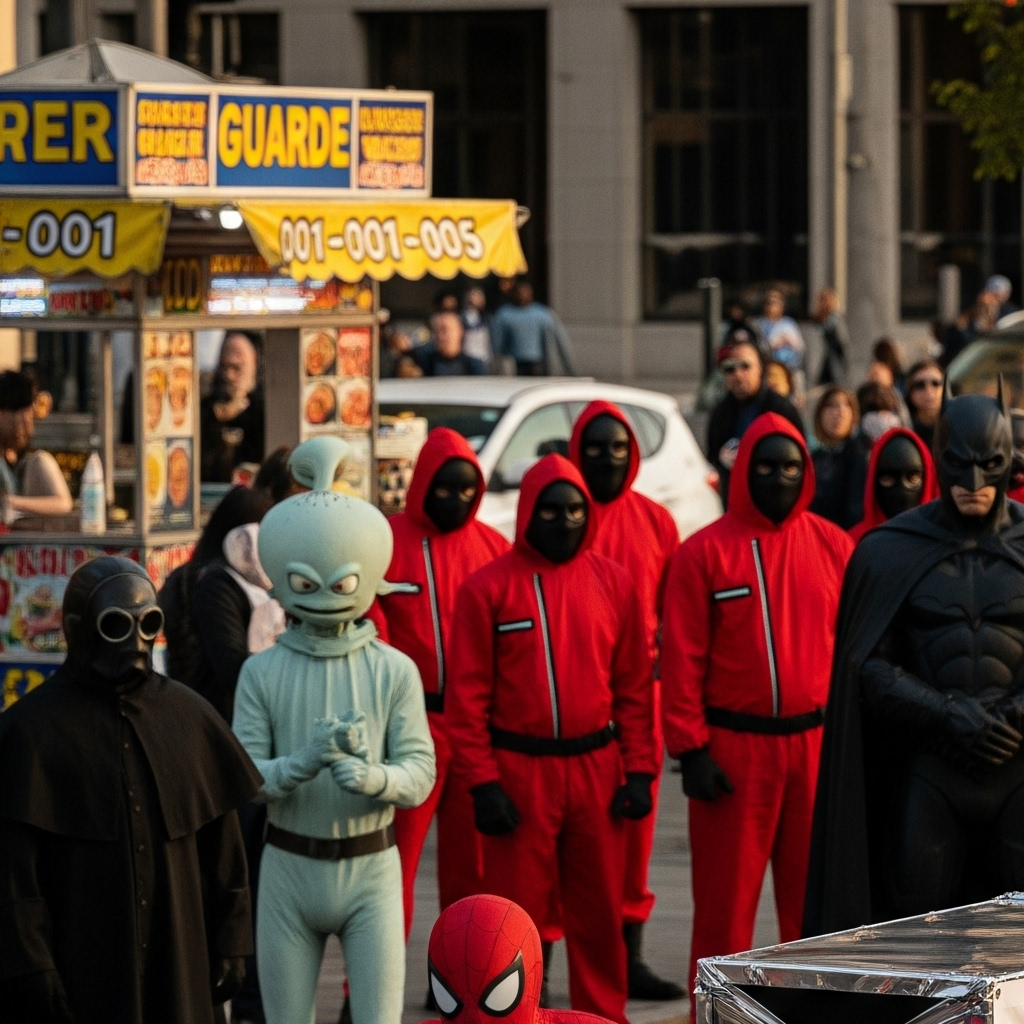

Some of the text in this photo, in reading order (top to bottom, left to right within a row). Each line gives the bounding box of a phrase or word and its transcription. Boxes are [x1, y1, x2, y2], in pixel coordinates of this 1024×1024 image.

[0, 100, 115, 163] RER
[218, 101, 351, 169] GUARDE
[280, 216, 485, 264] 001-001-005
